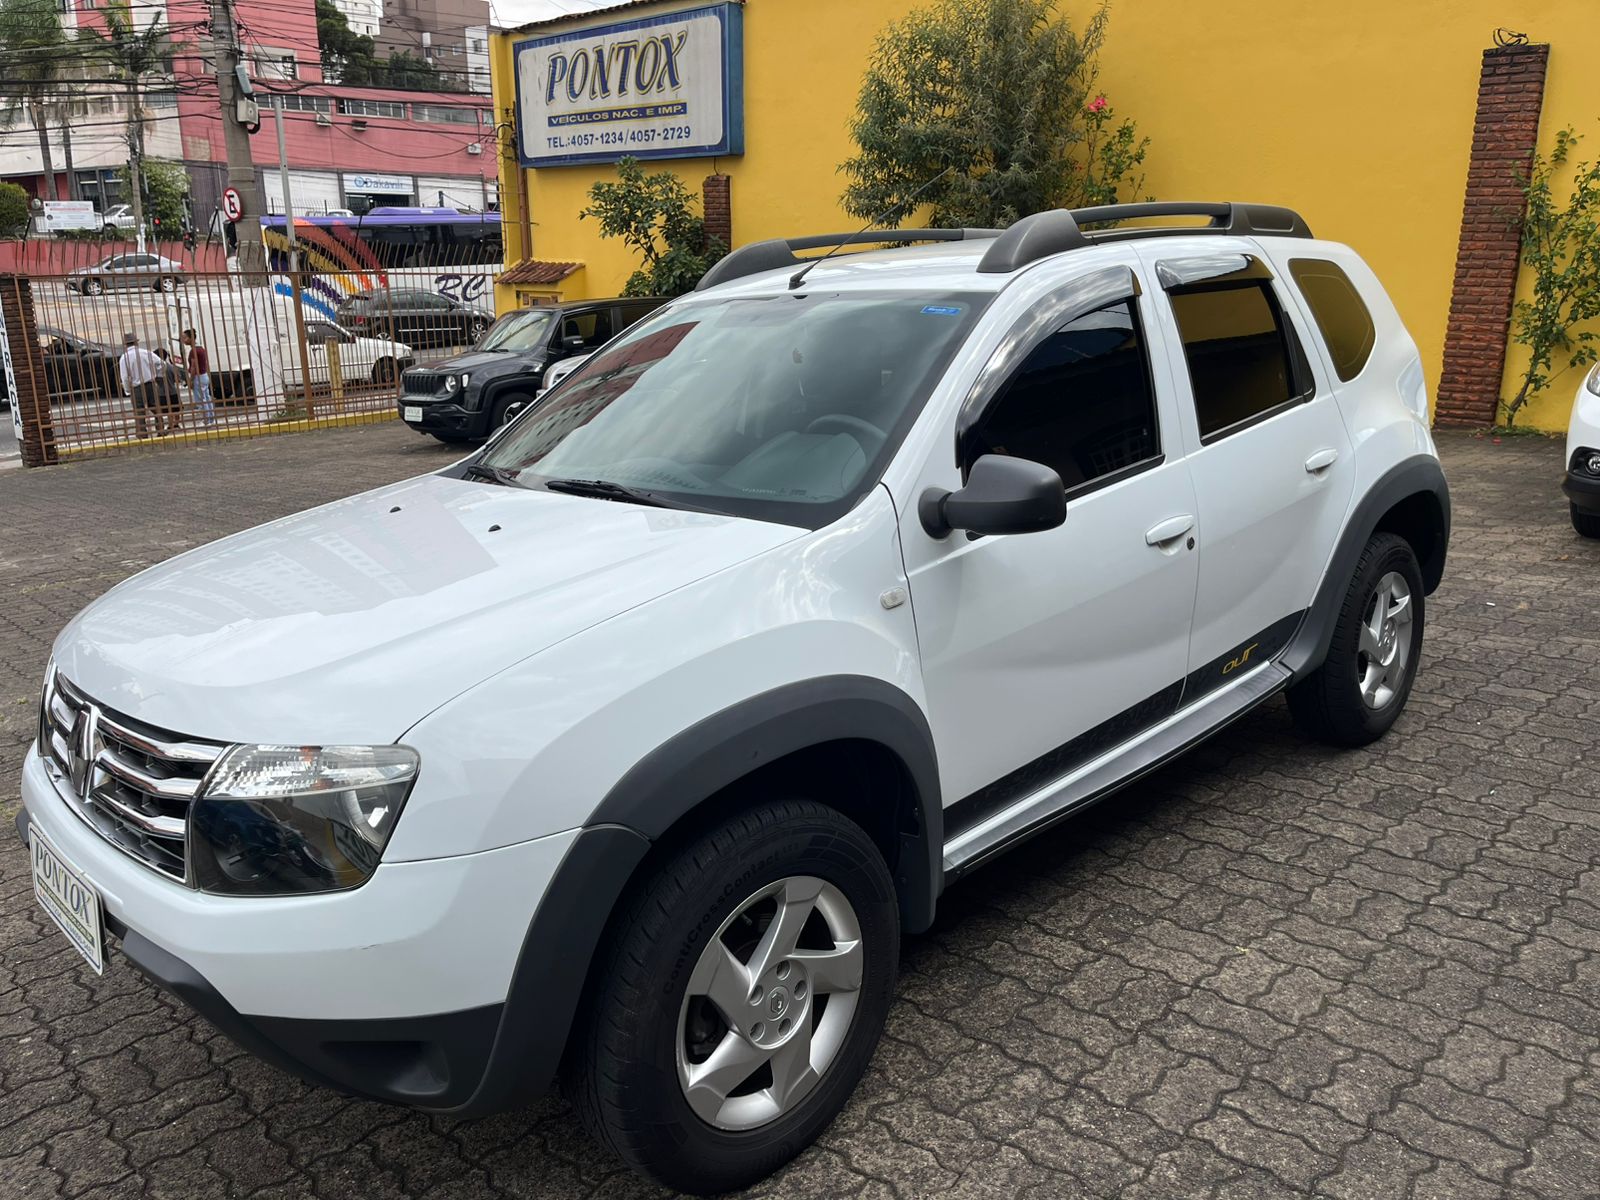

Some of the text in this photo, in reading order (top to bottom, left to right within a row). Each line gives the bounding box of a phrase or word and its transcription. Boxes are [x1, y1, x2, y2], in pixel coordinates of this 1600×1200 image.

[546, 30, 687, 105] PONTOX
[613, 109, 643, 119] NAC.
[646, 108, 654, 116] E
[658, 105, 684, 114] IMP.
[34, 840, 92, 929] PONTOX
